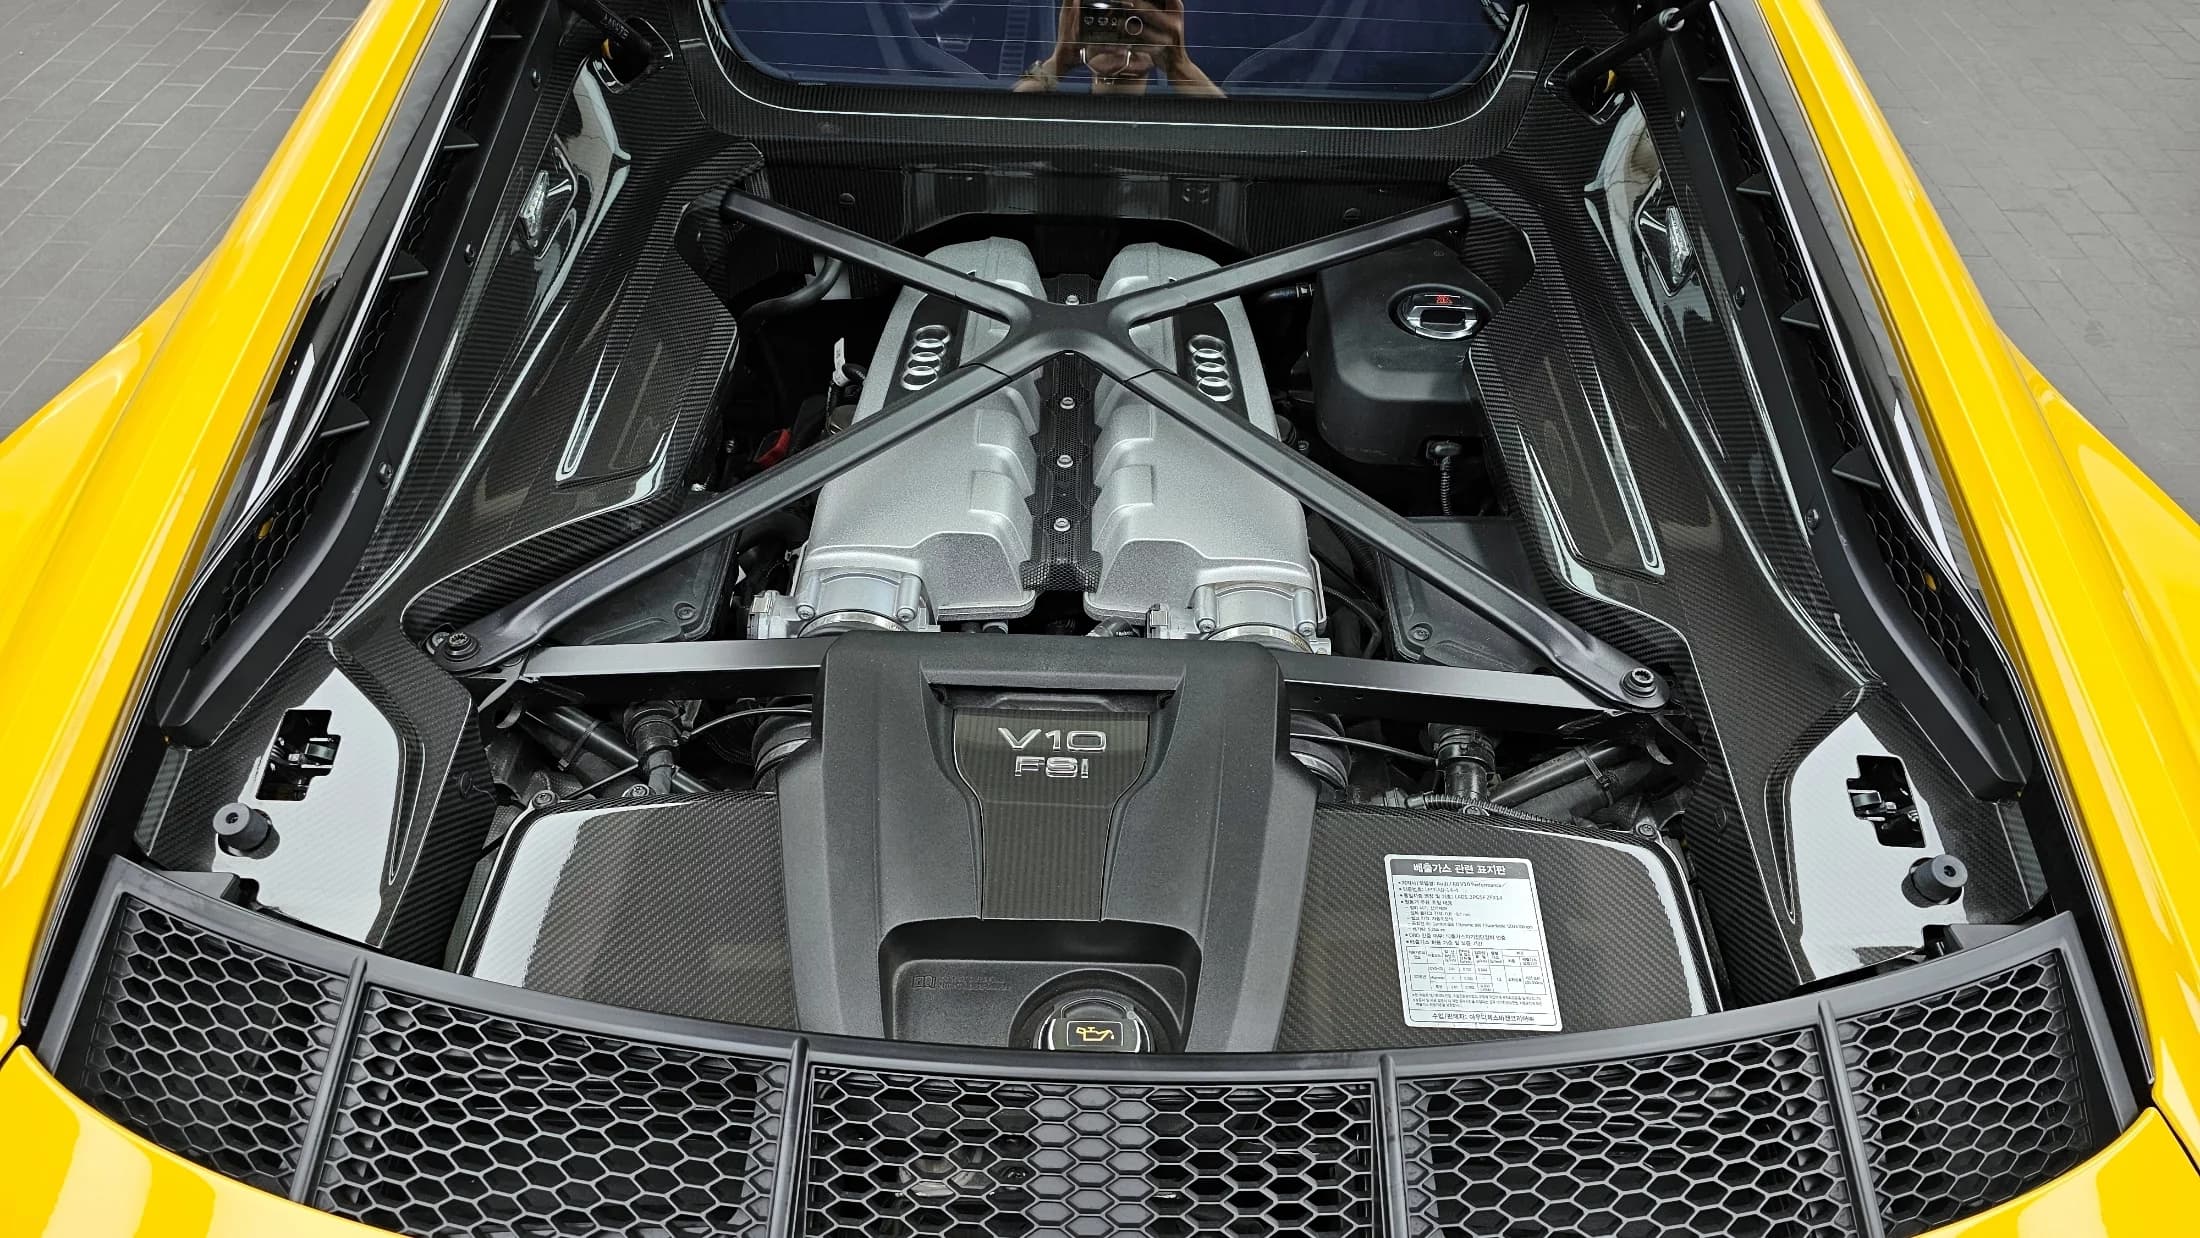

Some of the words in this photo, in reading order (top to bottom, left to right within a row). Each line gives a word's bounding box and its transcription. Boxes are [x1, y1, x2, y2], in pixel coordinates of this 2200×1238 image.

[998, 727, 1107, 752] V10
[1014, 756, 1089, 778] FSI
[1413, 863, 1452, 873] 배출가스
[1455, 864, 1474, 874] 관련
[1477, 865, 1506, 875] 표지판
